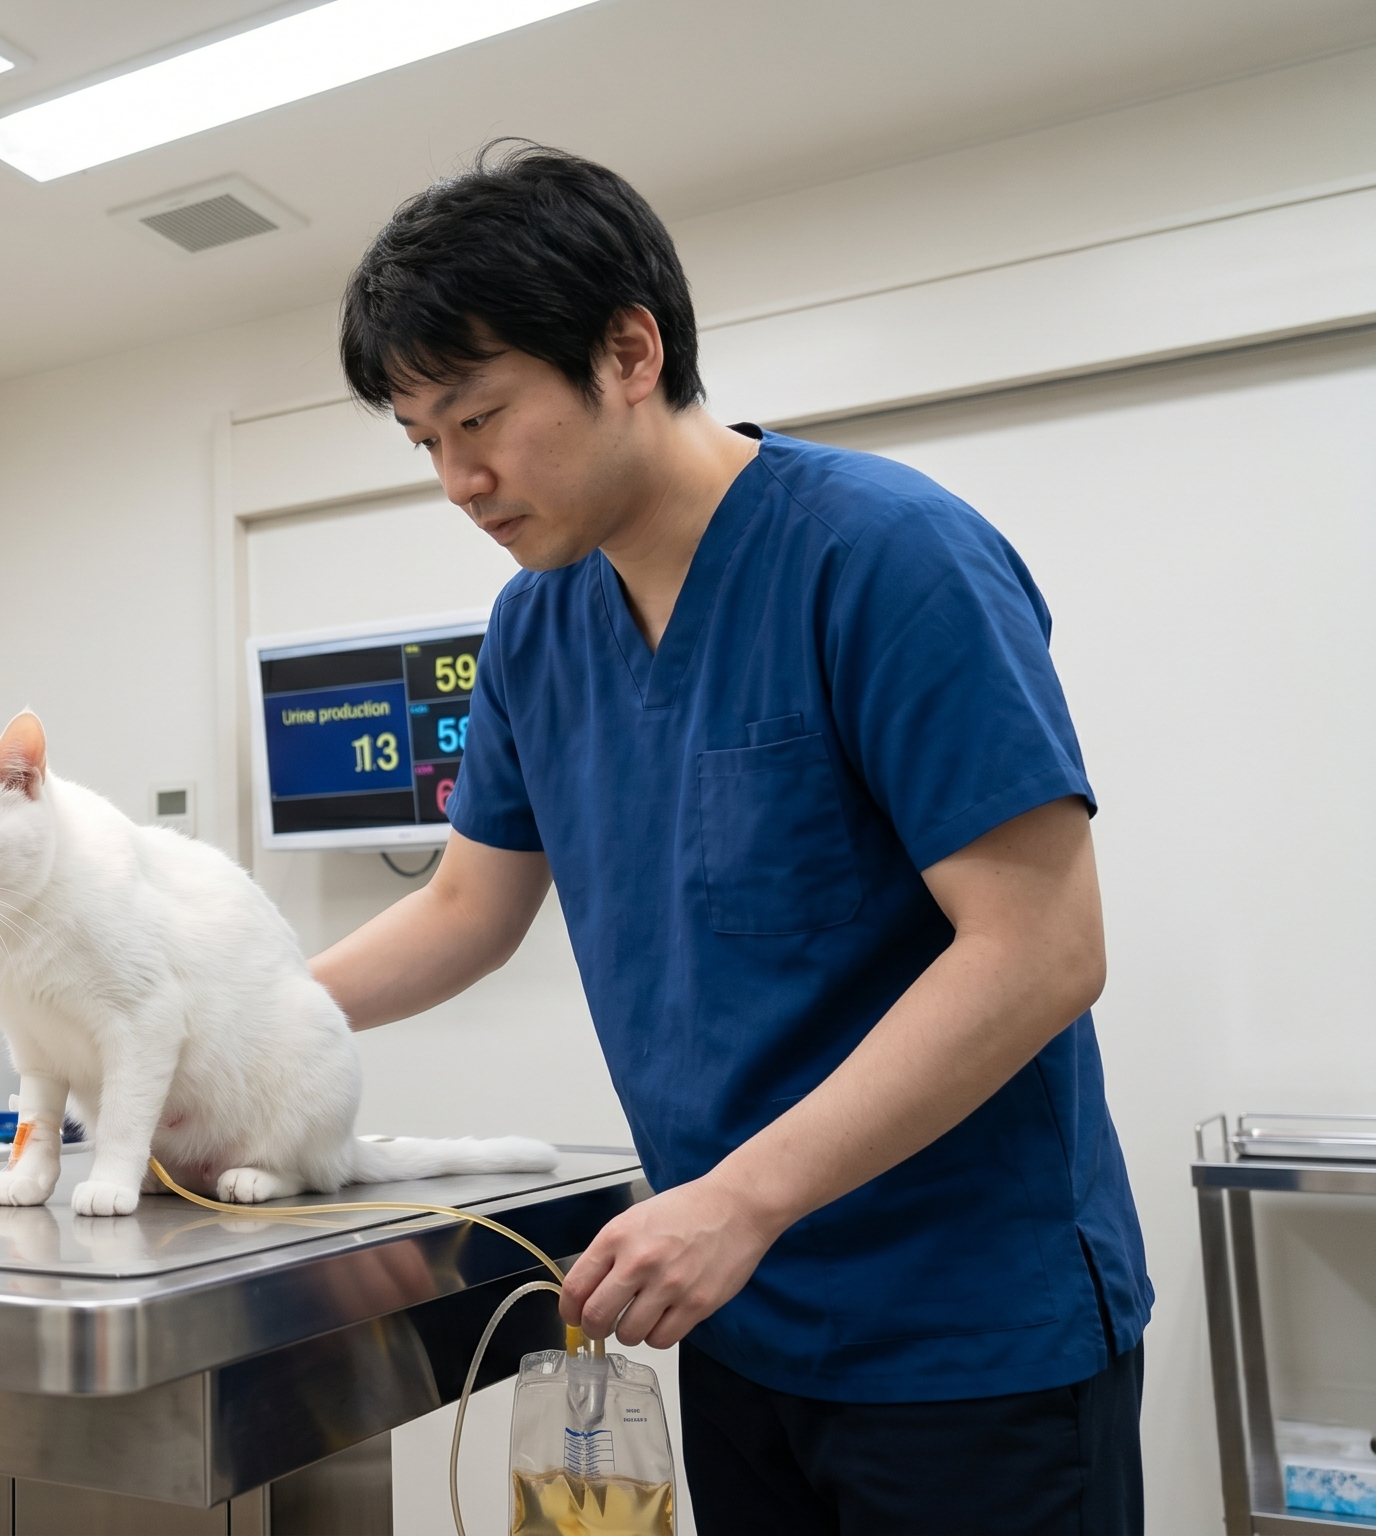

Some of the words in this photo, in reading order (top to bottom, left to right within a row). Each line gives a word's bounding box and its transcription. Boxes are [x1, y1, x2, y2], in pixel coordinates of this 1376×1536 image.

[435, 654, 477, 692] 59
[281, 707, 317, 726] Urine
[319, 700, 391, 725] production
